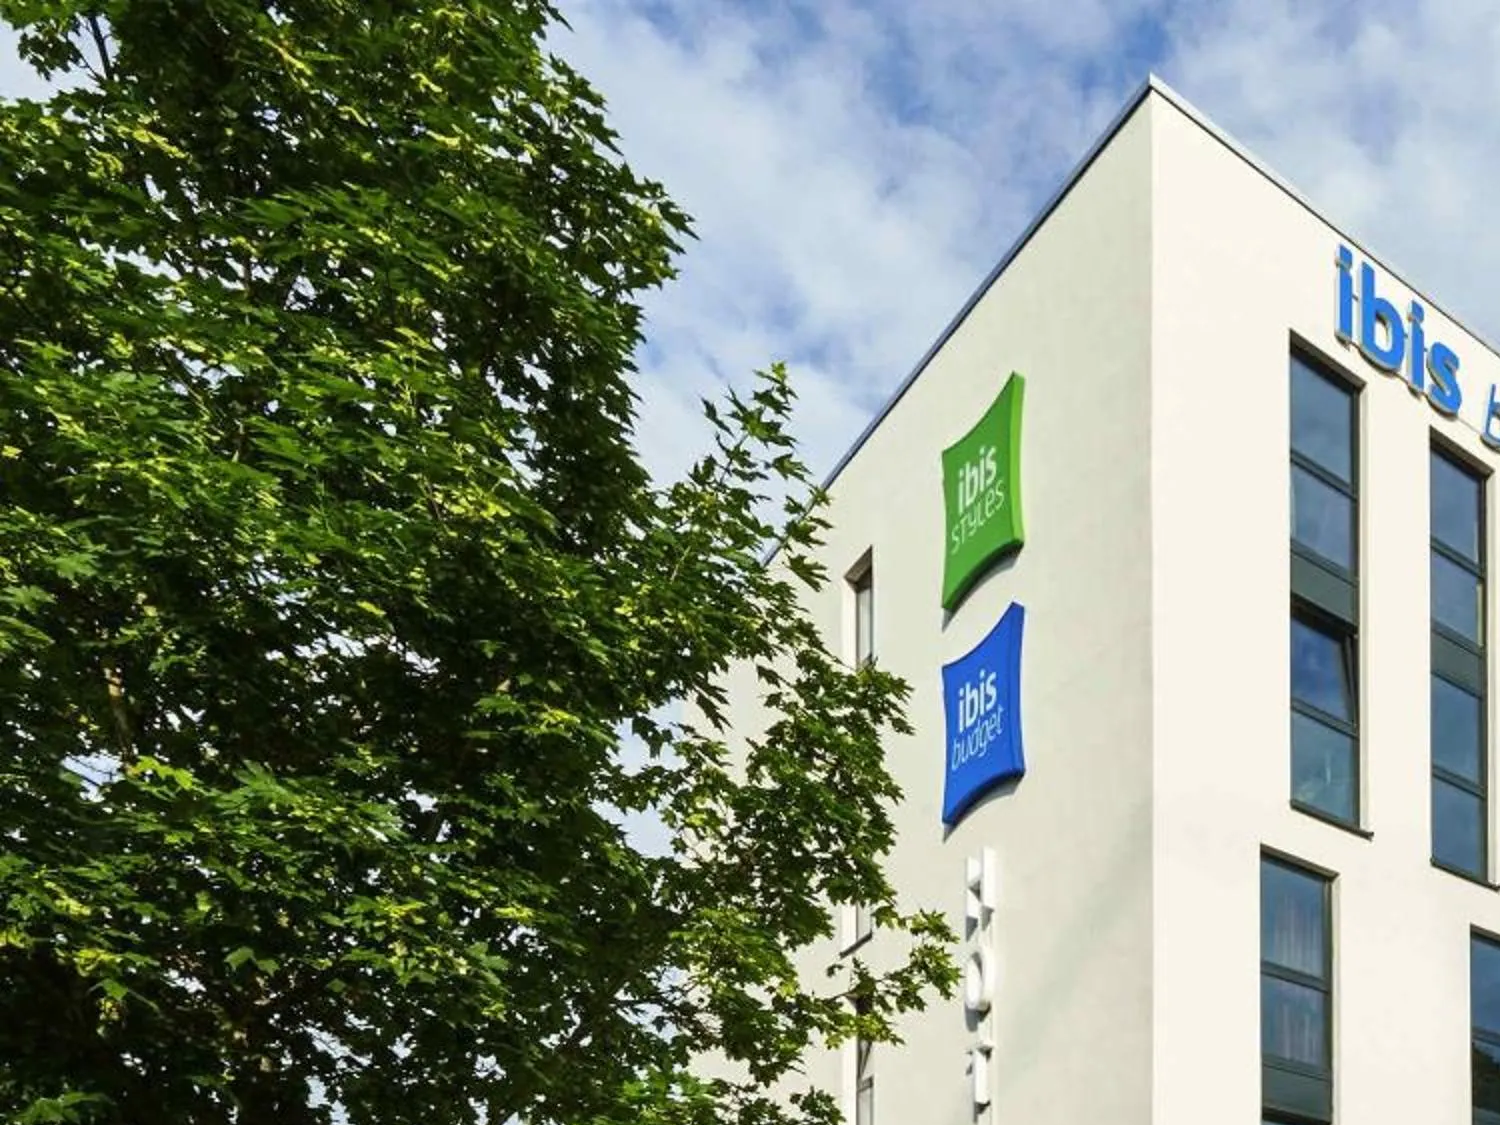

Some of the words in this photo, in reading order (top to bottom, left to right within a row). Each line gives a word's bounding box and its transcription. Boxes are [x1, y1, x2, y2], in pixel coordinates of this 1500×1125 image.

[1335, 243, 1463, 420] ibis
[958, 445, 997, 516] ibis
[958, 669, 997, 734] ibis
[951, 704, 1004, 772] budget
